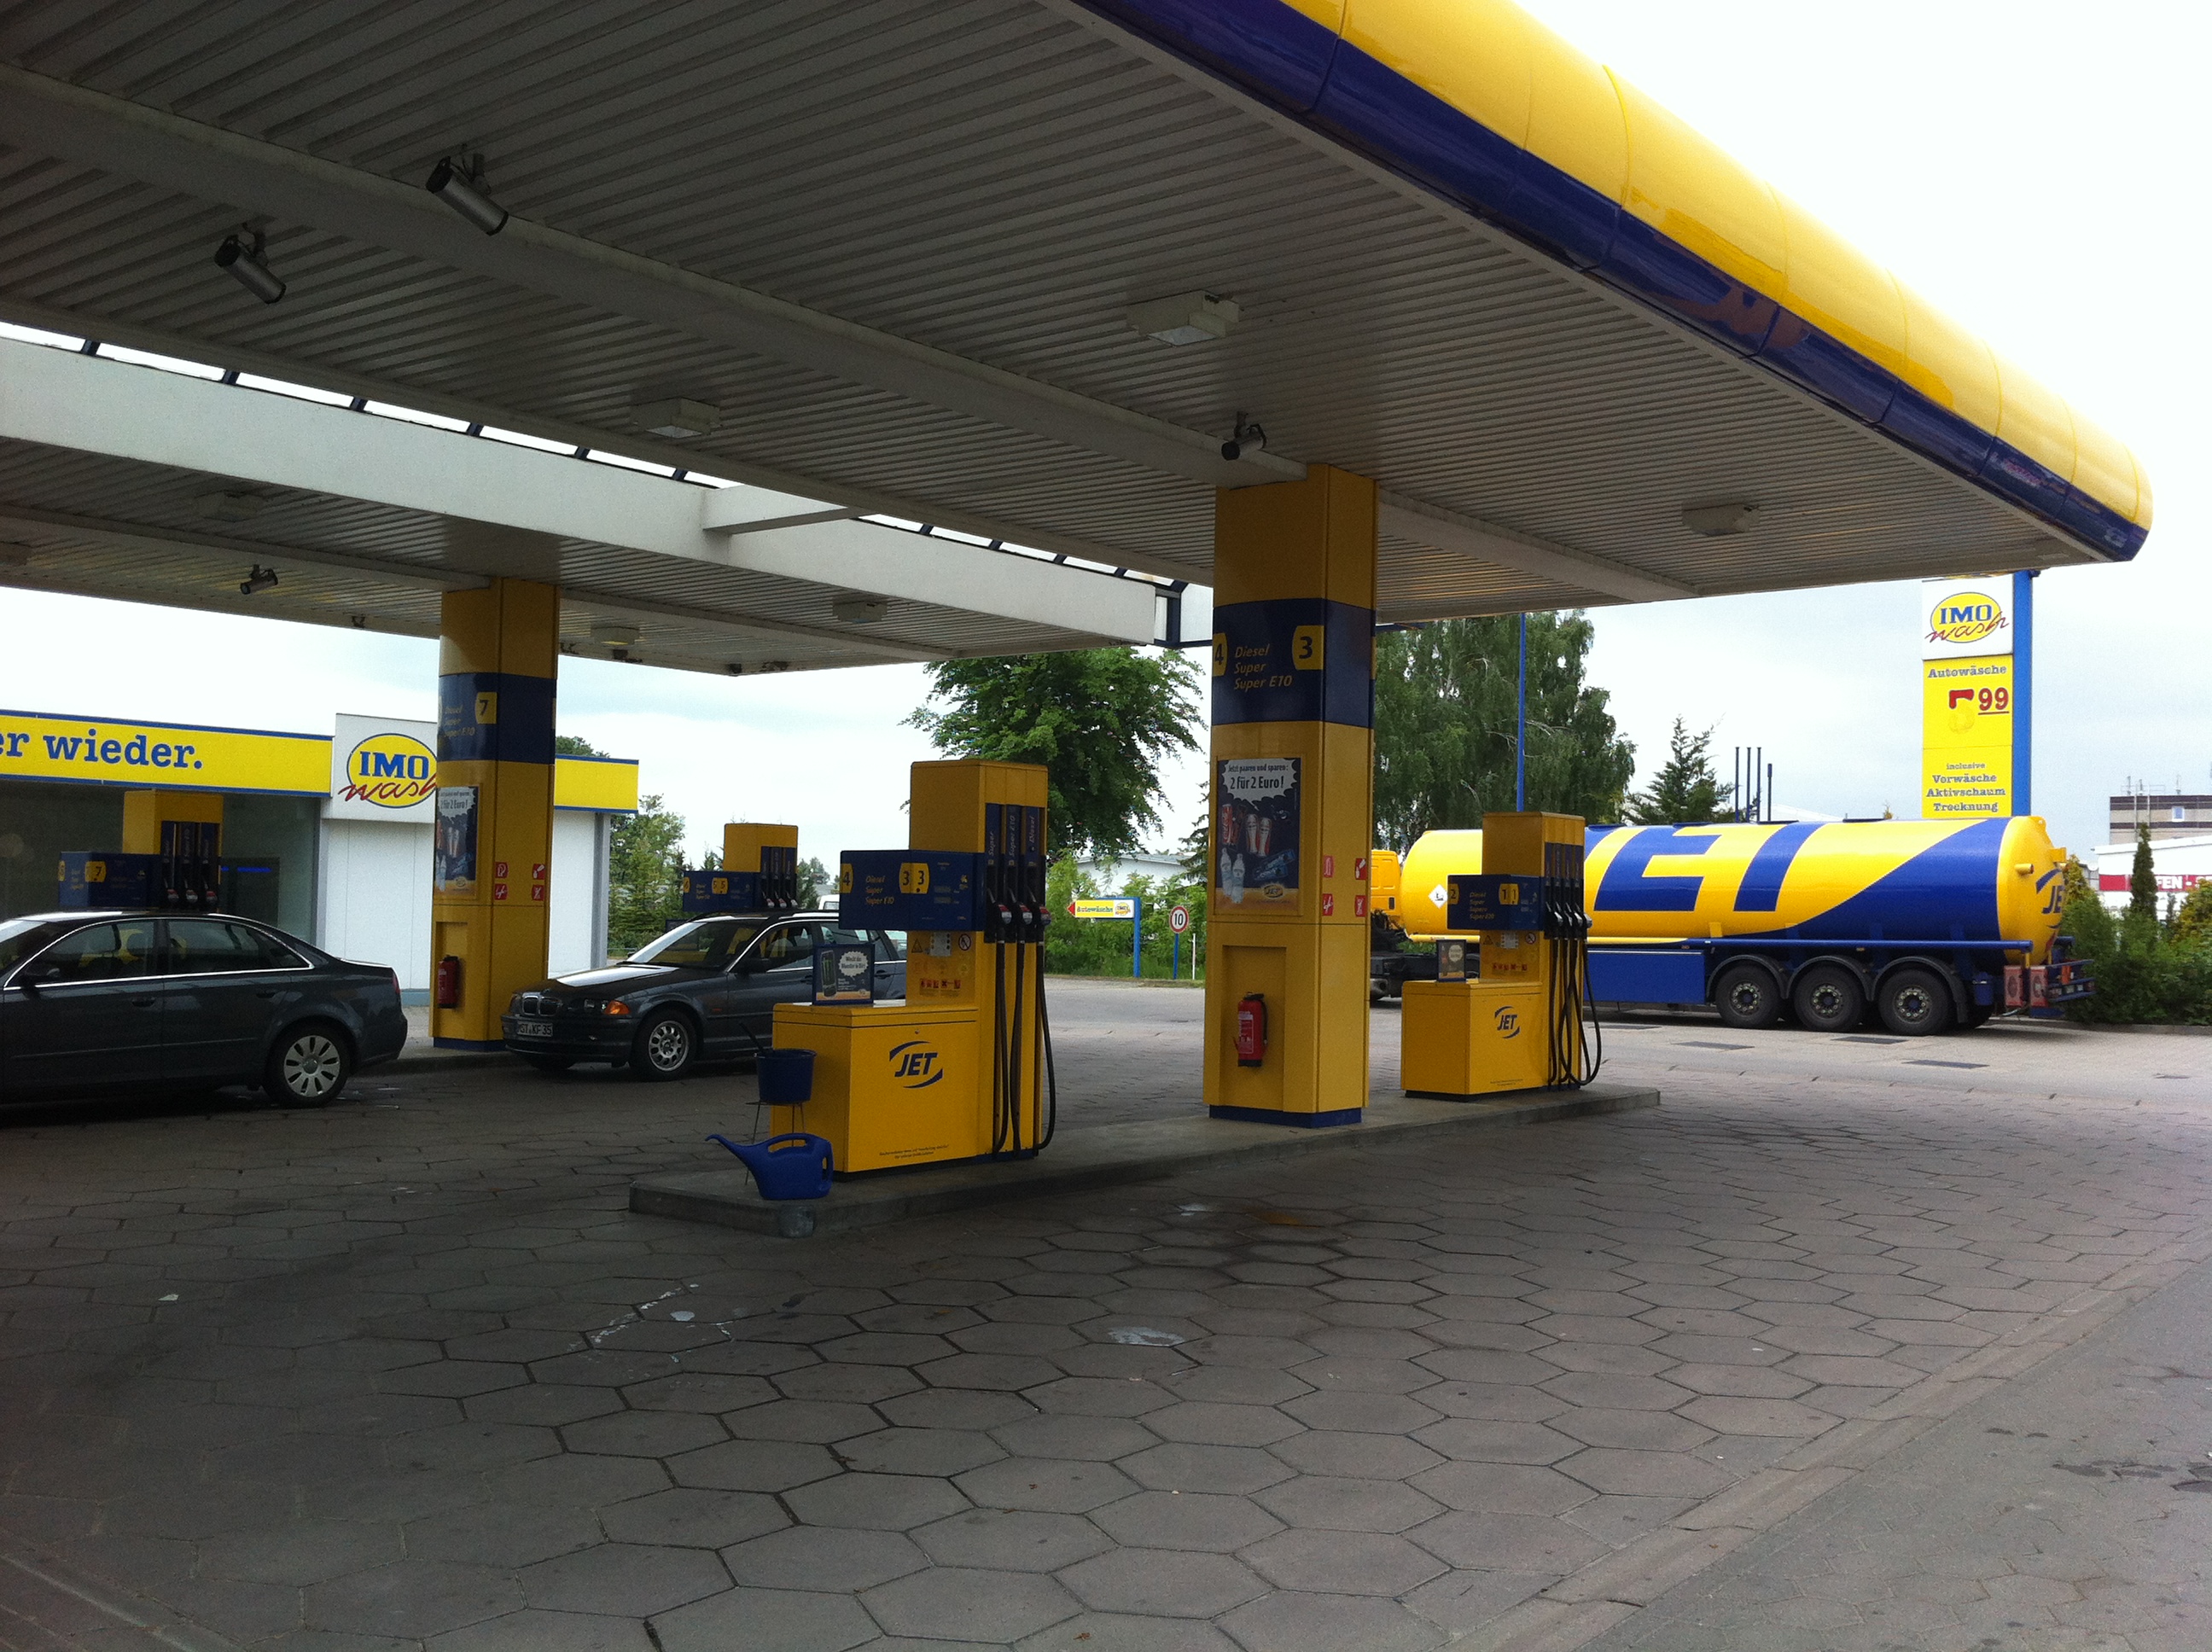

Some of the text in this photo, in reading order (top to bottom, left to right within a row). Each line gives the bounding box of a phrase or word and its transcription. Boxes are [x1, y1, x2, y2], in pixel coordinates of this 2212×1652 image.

[1939, 604, 1993, 625] IMO
[1924, 611, 2010, 643] wash
[1214, 643, 1224, 666] 4
[1235, 643, 1271, 658] Diesel
[1298, 636, 1313, 660] 3
[1234, 662, 1266, 676] Super
[1927, 666, 2007, 678] Autowäsche
[1234, 675, 1293, 693] Super E10
[479, 699, 489, 716] 7
[1978, 687, 2009, 711] 99
[43, 728, 203, 770] wieder.
[359, 751, 429, 780] IMO
[1230, 777, 1235, 789] 2
[1237, 776, 1249, 789] für
[1250, 776, 1256, 788] 2
[1932, 773, 1998, 783] Vorwäsche
[1926, 788, 2005, 797] Aktivschaum
[1933, 802, 1999, 812] Trocknung
[902, 870, 910, 885] 3
[917, 870, 925, 885] 3
[2042, 885, 2064, 915] JE
[1174, 913, 1184, 926] 10
[1497, 1014, 1518, 1031] JET
[894, 1051, 939, 1078] JET
